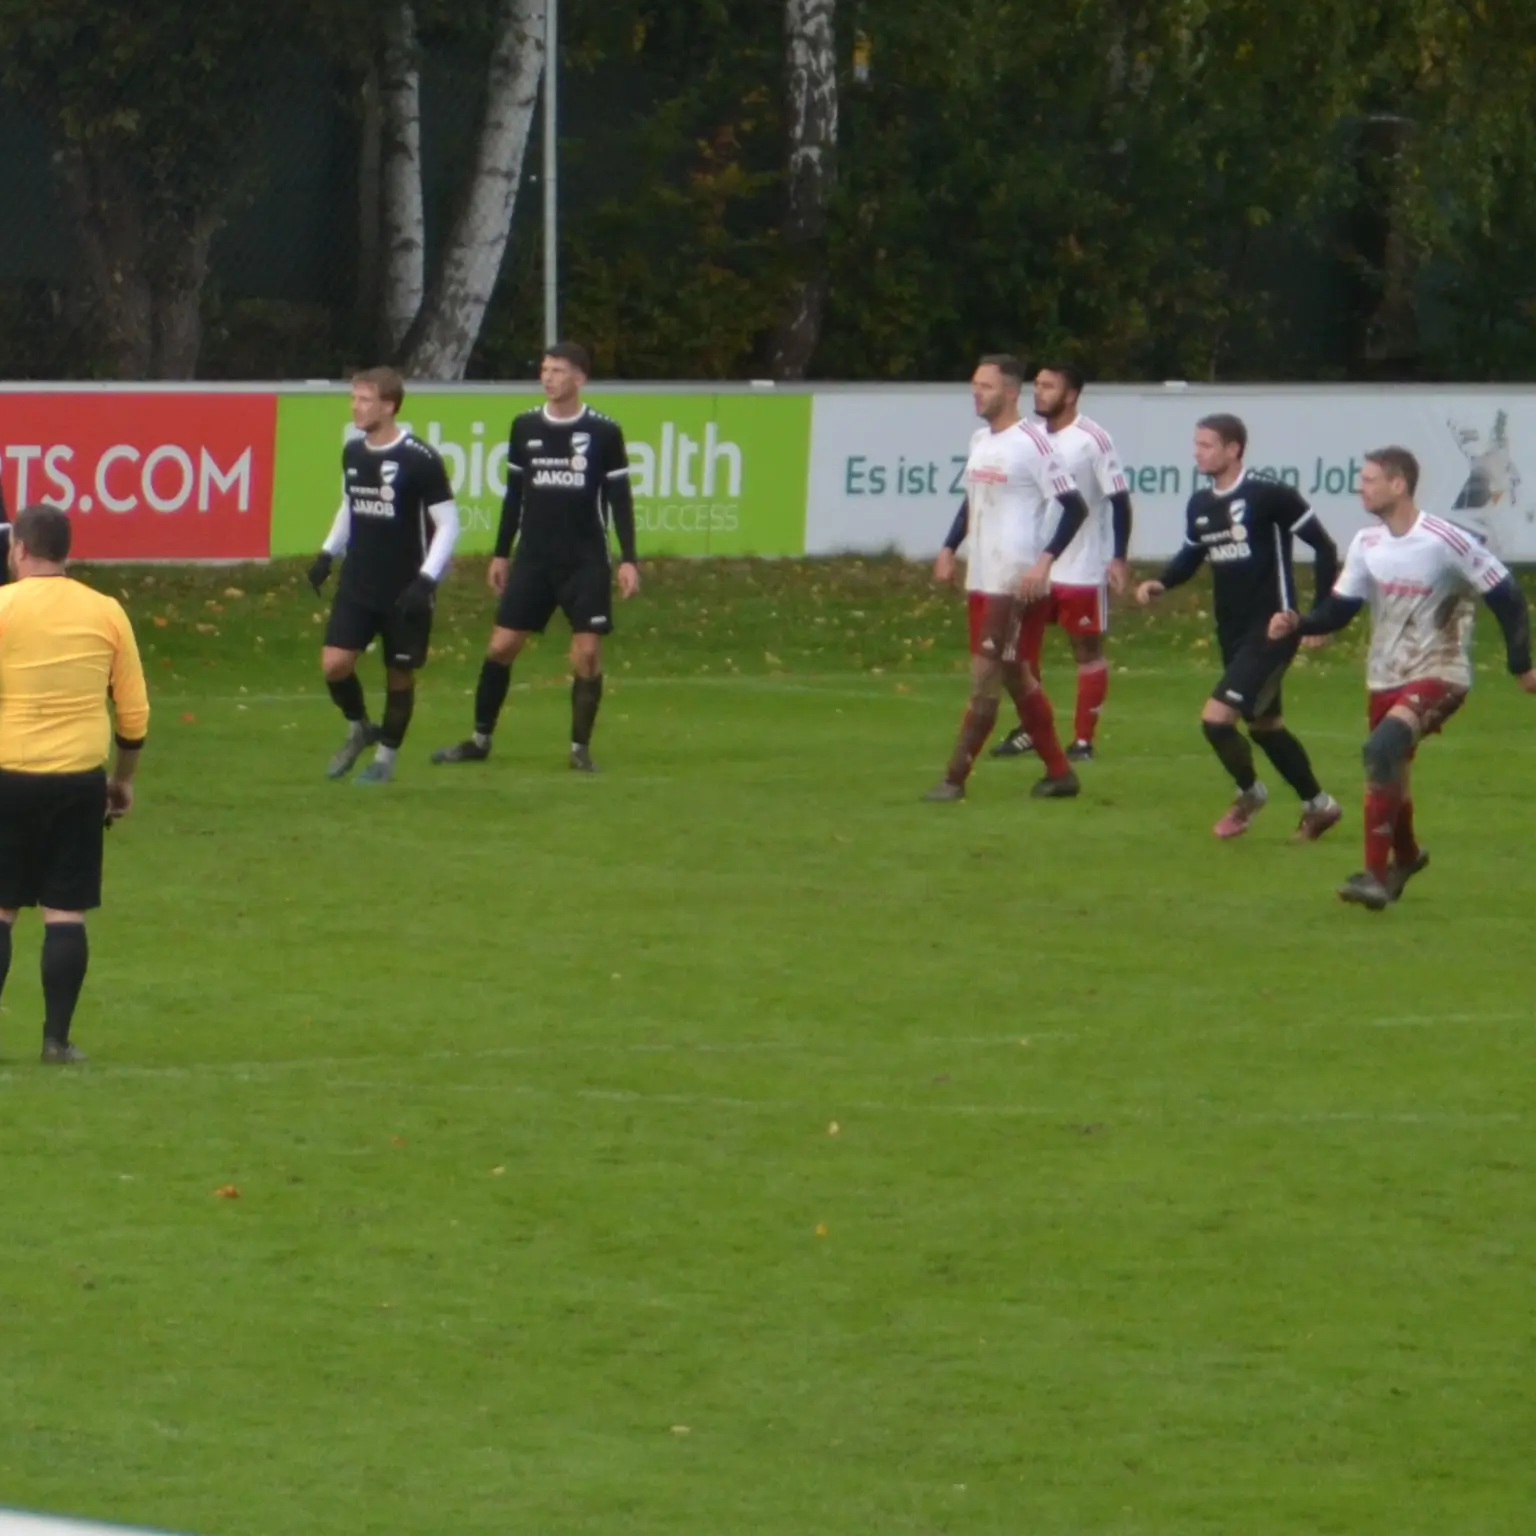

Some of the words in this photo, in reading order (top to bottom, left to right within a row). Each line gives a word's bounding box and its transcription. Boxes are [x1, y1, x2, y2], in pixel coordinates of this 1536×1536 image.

[532, 469, 586, 487] JAKOB
[844, 454, 887, 496] Es
[896, 455, 939, 496] ist
